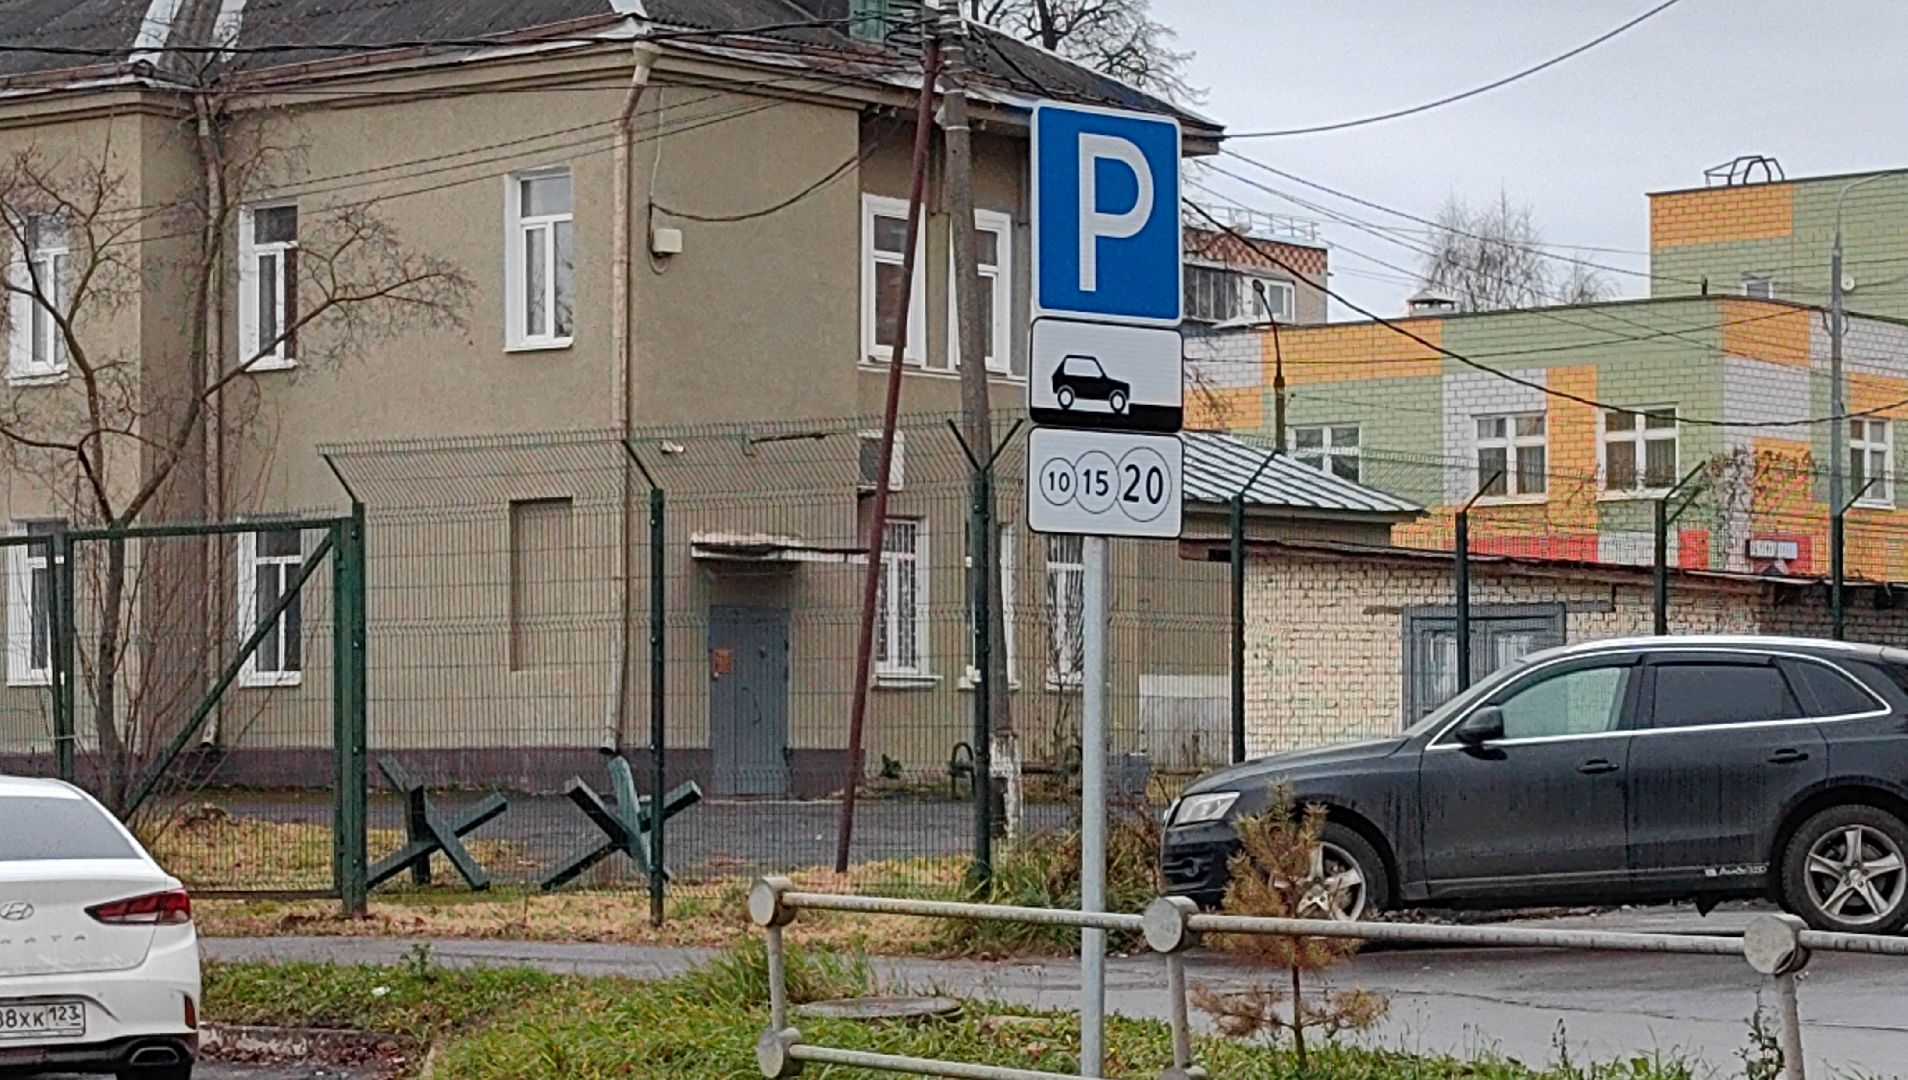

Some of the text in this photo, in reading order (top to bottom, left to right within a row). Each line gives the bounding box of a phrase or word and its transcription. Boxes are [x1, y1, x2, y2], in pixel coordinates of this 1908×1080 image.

[1079, 131, 1155, 293] P
[1049, 464, 1164, 505] 10 15 20
[49, 1004, 78, 1021] 123
